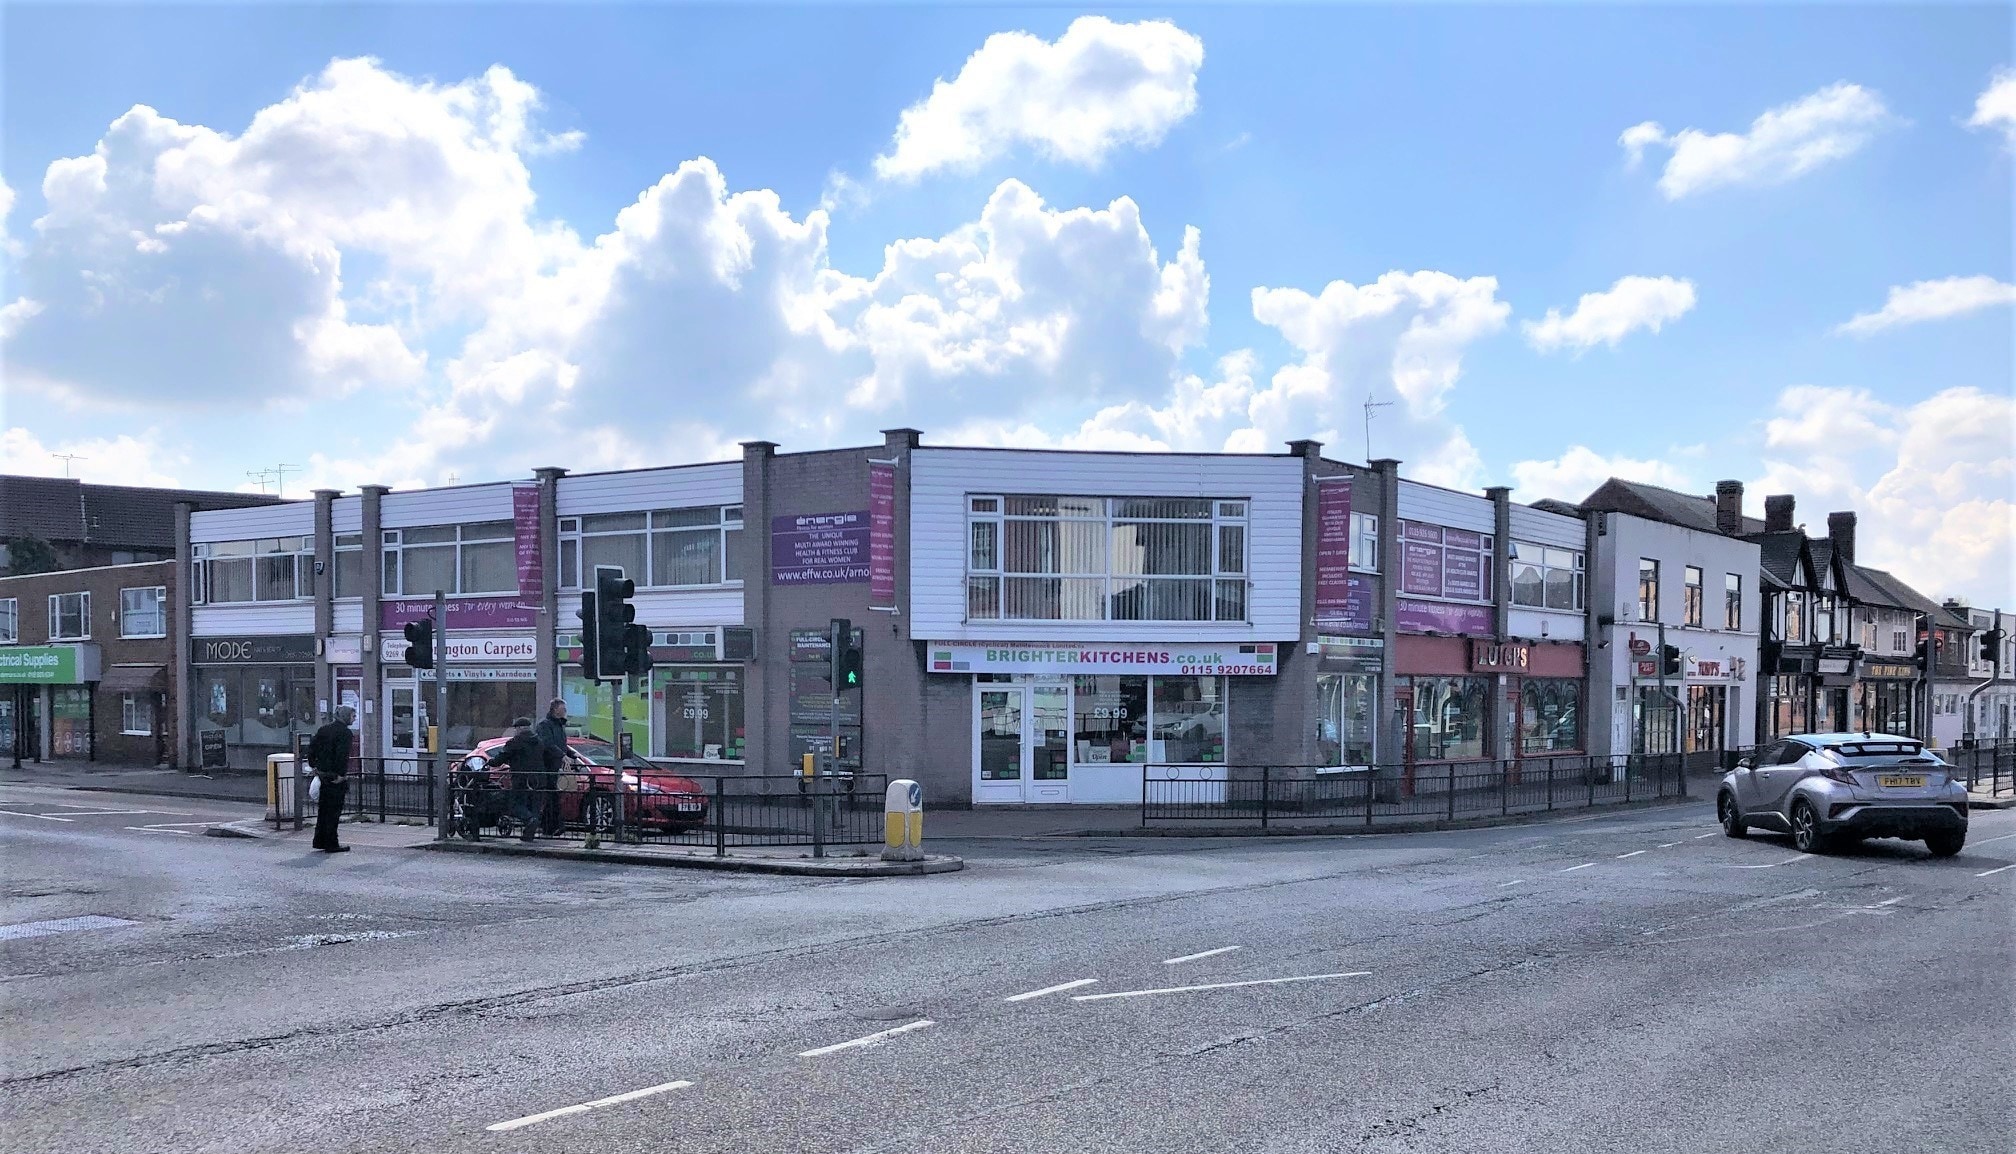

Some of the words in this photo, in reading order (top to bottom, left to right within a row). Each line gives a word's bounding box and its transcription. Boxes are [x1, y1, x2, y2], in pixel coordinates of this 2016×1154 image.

[822, 531, 843, 540] UNIQUE
[795, 541, 811, 549] MULTI
[833, 539, 859, 547] WINNING
[796, 549, 815, 557] HEALTH
[843, 547, 858, 555] CLUB
[803, 557, 814, 565] FOR
[395, 602, 405, 613] 30
[407, 604, 433, 613] minute
[477, 601, 496, 616] every
[206, 641, 252, 659] MODE
[484, 641, 533, 657] Carpets
[23, 653, 59, 669] Supplies
[1478, 645, 1528, 667] LUIGI'S
[464, 670, 486, 678] Vinyls
[1181, 665, 1212, 675] 0115
[1218, 665, 1272, 675] 9207664
[683, 708, 708, 719] £9.99
[1094, 707, 1128, 719] £9.99
